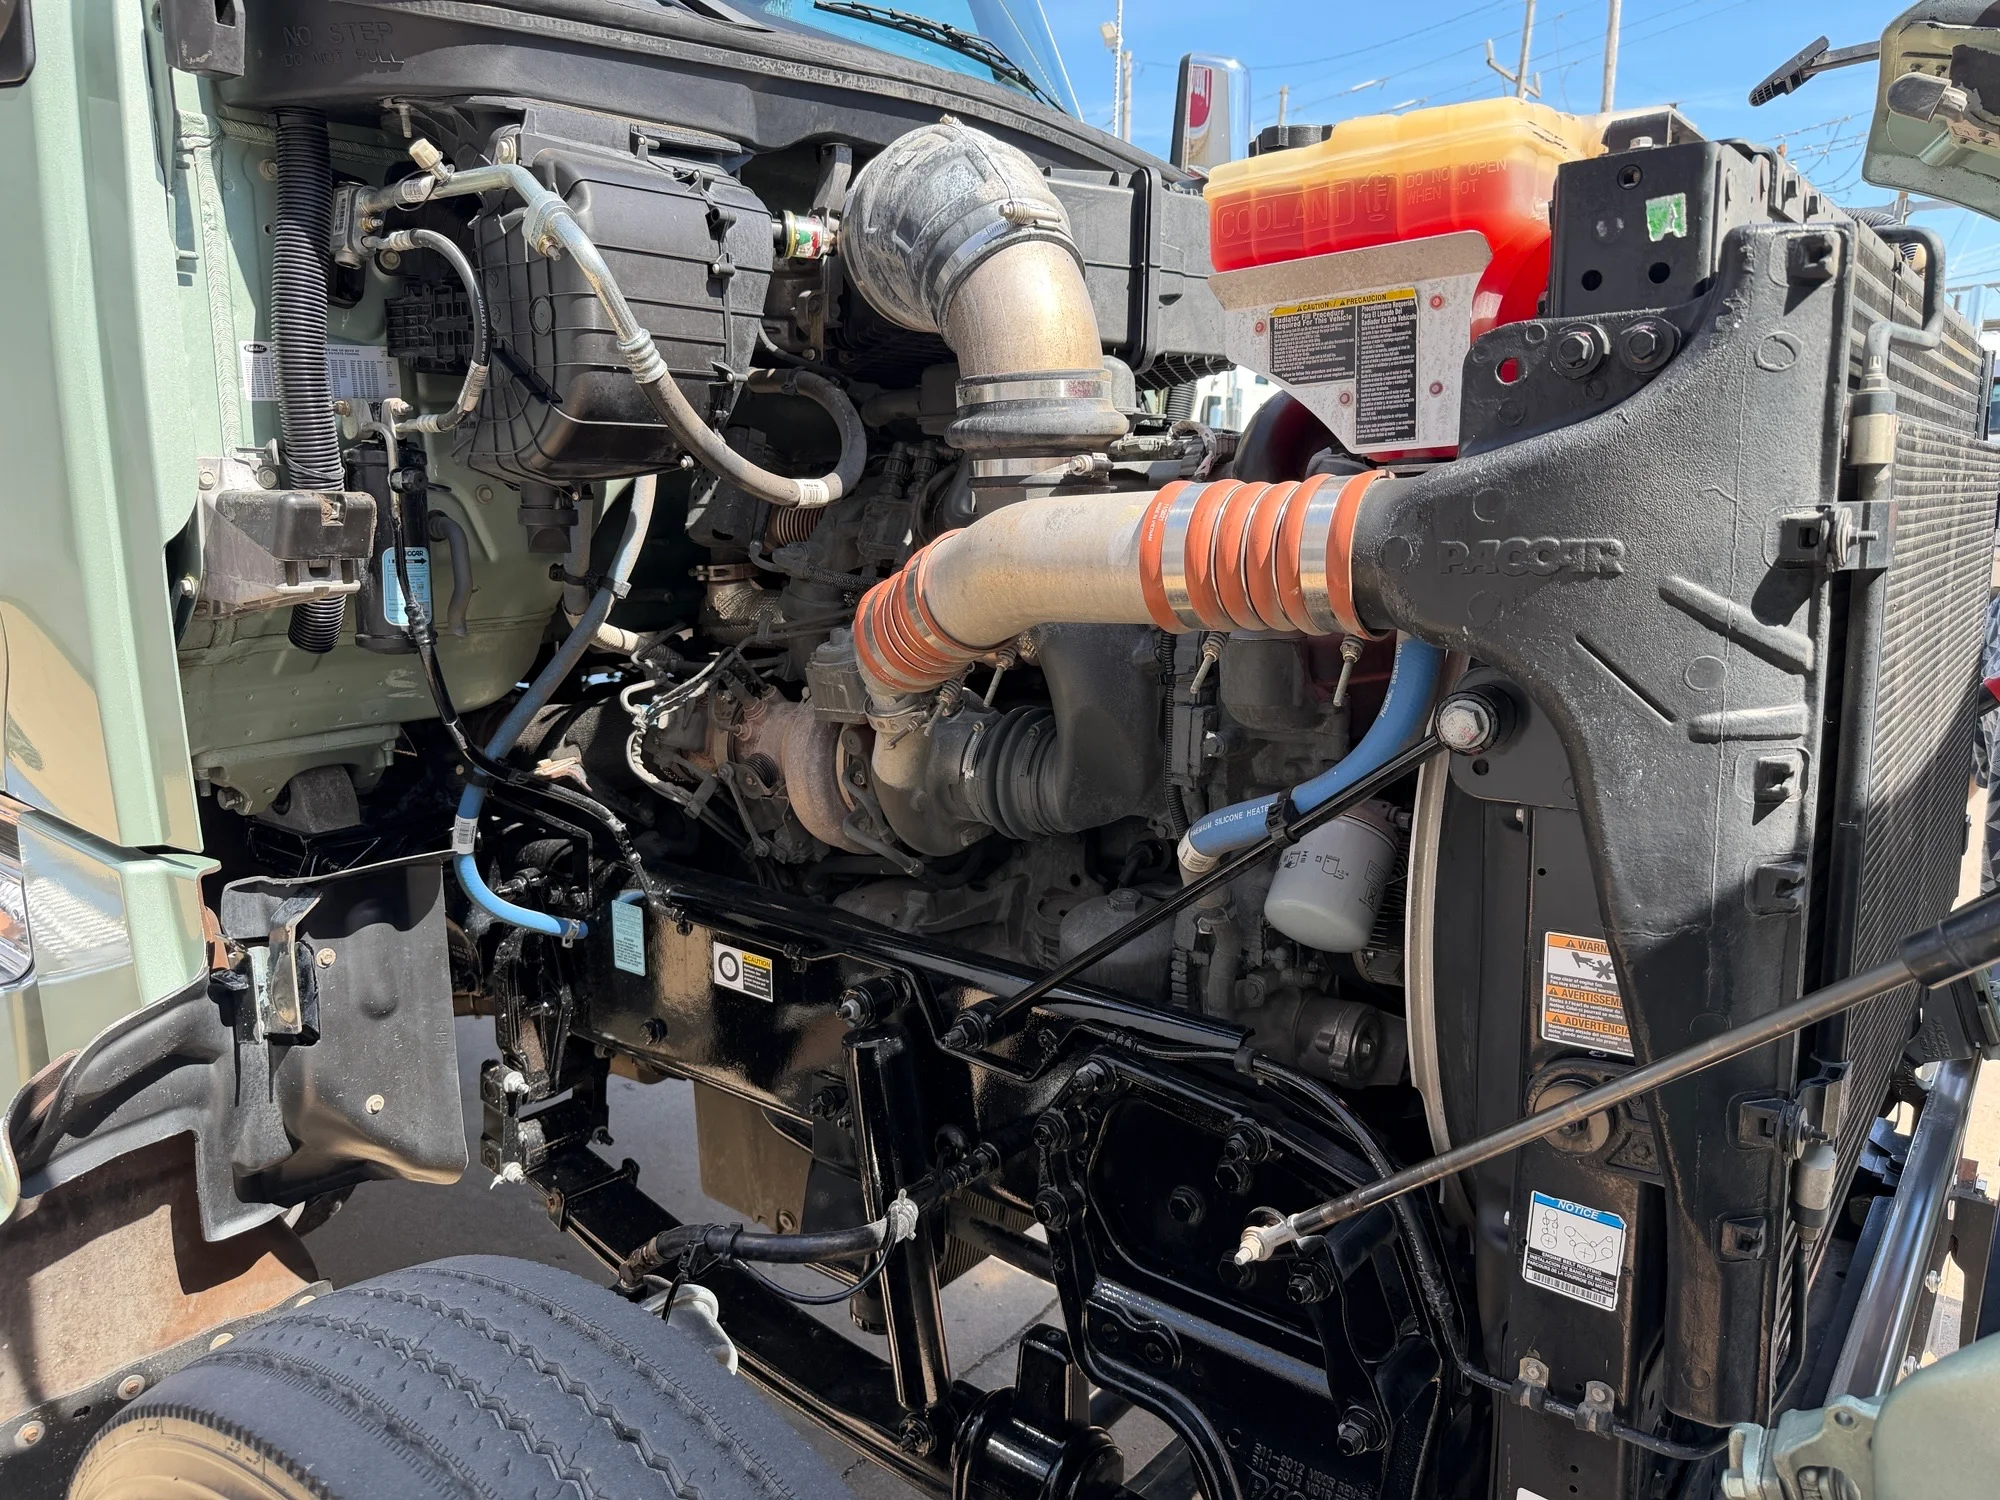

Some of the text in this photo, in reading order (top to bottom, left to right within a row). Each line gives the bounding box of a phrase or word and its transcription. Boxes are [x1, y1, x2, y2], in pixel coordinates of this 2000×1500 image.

[282, 21, 393, 46] NO STEP
[283, 49, 404, 66] DO NOT PULL
[1406, 160, 1507, 188] DO NOT OPEN
[1406, 179, 1478, 204] WHEN HOT
[1221, 187, 1346, 238] COOLANT
[1303, 302, 1329, 311] CAUTION
[1347, 294, 1386, 304] PRECAUCION
[1313, 310, 1344, 318] Procedure
[1274, 321, 1300, 330] Required
[1330, 314, 1352, 322] Vehicle
[1440, 536, 1624, 576] PACCAR
[1190, 822, 1212, 837] PREMIUM
[1215, 812, 1243, 826] SILICONE
[1578, 940, 1610, 953] WARN
[748, 956, 770, 967] CAUTION
[1558, 1201, 1600, 1220] NOTICE
[1530, 1254, 1560, 1268] INSTALACION
[1569, 1267, 1586, 1277] BANDA
[1595, 1275, 1614, 1286] MOTOR
[1542, 1252, 1561, 1261] ENGINE
[1577, 1263, 1602, 1276] ROUTING
[1528, 1260, 1550, 1272] PARCOURS
[1595, 1282, 1615, 1293] MOTEUR
